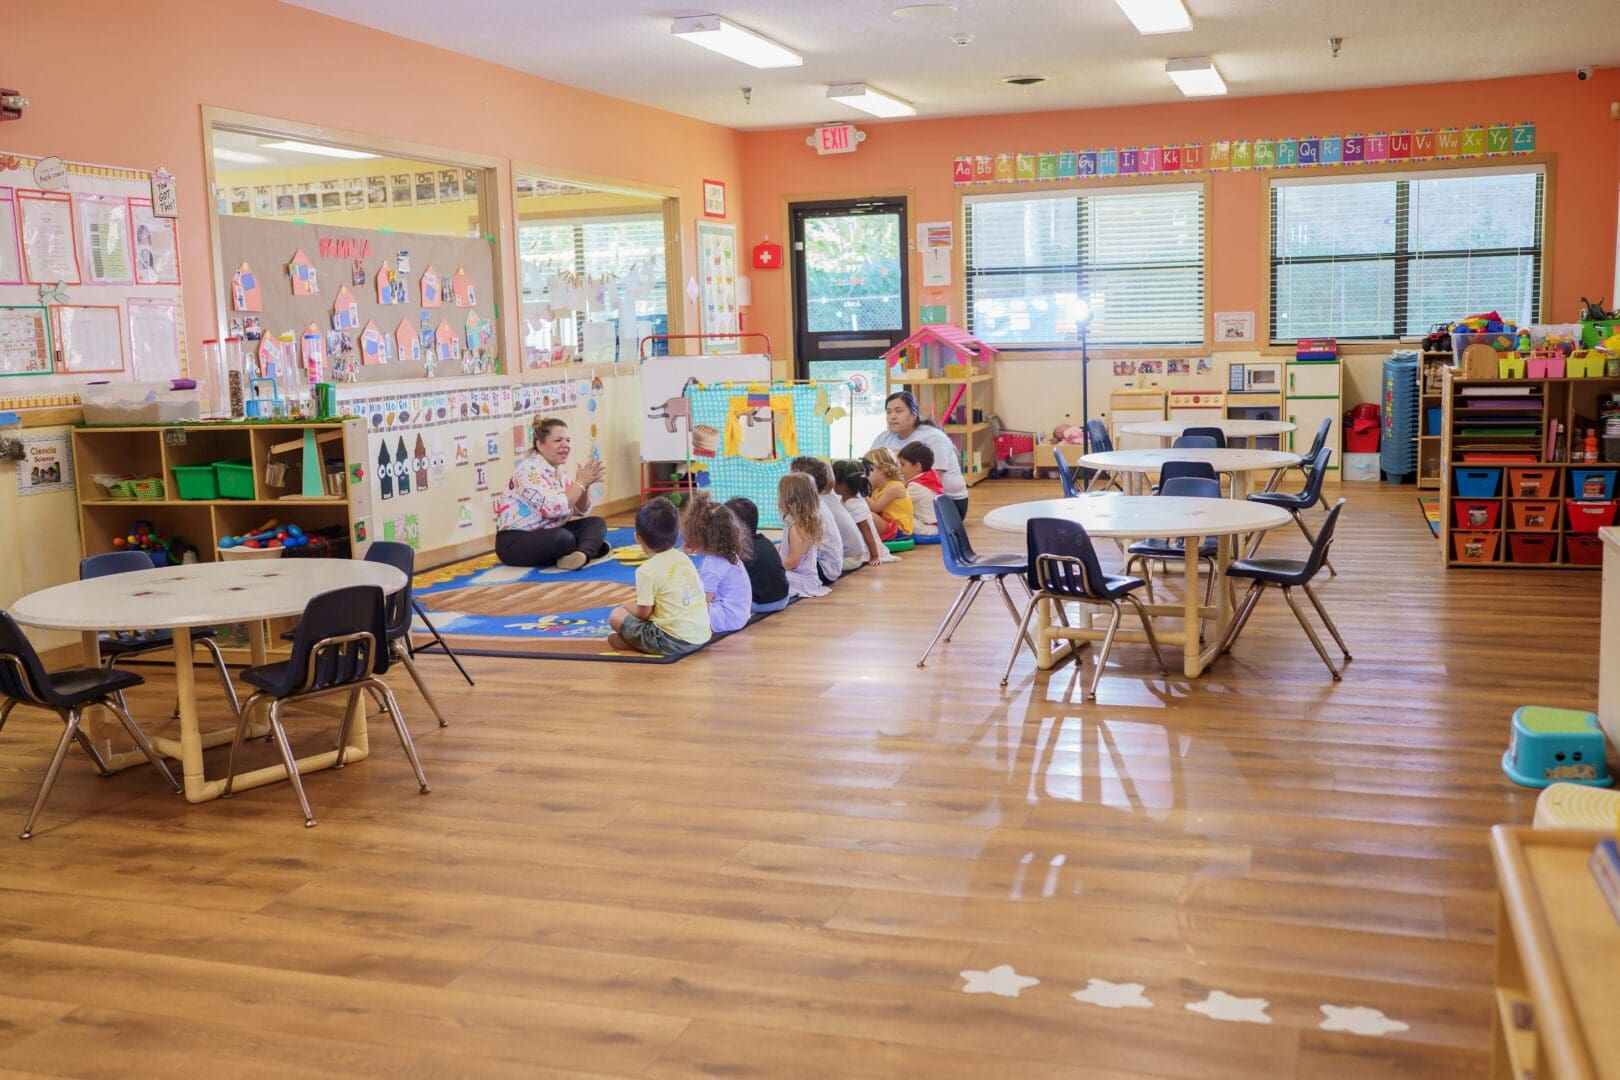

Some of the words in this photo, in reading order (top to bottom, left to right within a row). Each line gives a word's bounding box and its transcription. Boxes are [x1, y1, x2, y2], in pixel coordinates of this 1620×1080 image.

[823, 127, 848, 150] EXIT
[955, 162, 970, 175] Aa
[977, 160, 991, 174] Bb
[1059, 156, 1074, 169] Ff
[1078, 154, 1094, 174] Gg
[1123, 152, 1135, 167] Ii
[1142, 151, 1157, 171] Jj
[1163, 150, 1178, 164] Kk
[1256, 144, 1272, 159] Oo
[1279, 143, 1294, 163] Pp
[1299, 142, 1317, 162] Qq
[1324, 141, 1339, 155] Rr
[1345, 139, 1361, 154] Ss
[1367, 138, 1384, 152] Tt
[1392, 136, 1408, 151] Uu
[1416, 135, 1432, 149] Vv
[1439, 133, 1458, 148] Ww
[1464, 132, 1481, 147] Xx
[1490, 130, 1507, 150] Yy
[1515, 128, 1532, 144] Zz
[31, 447, 56, 455] Ciencia
[456, 443, 467, 459] Aa
[488, 439, 498, 455] Ee
